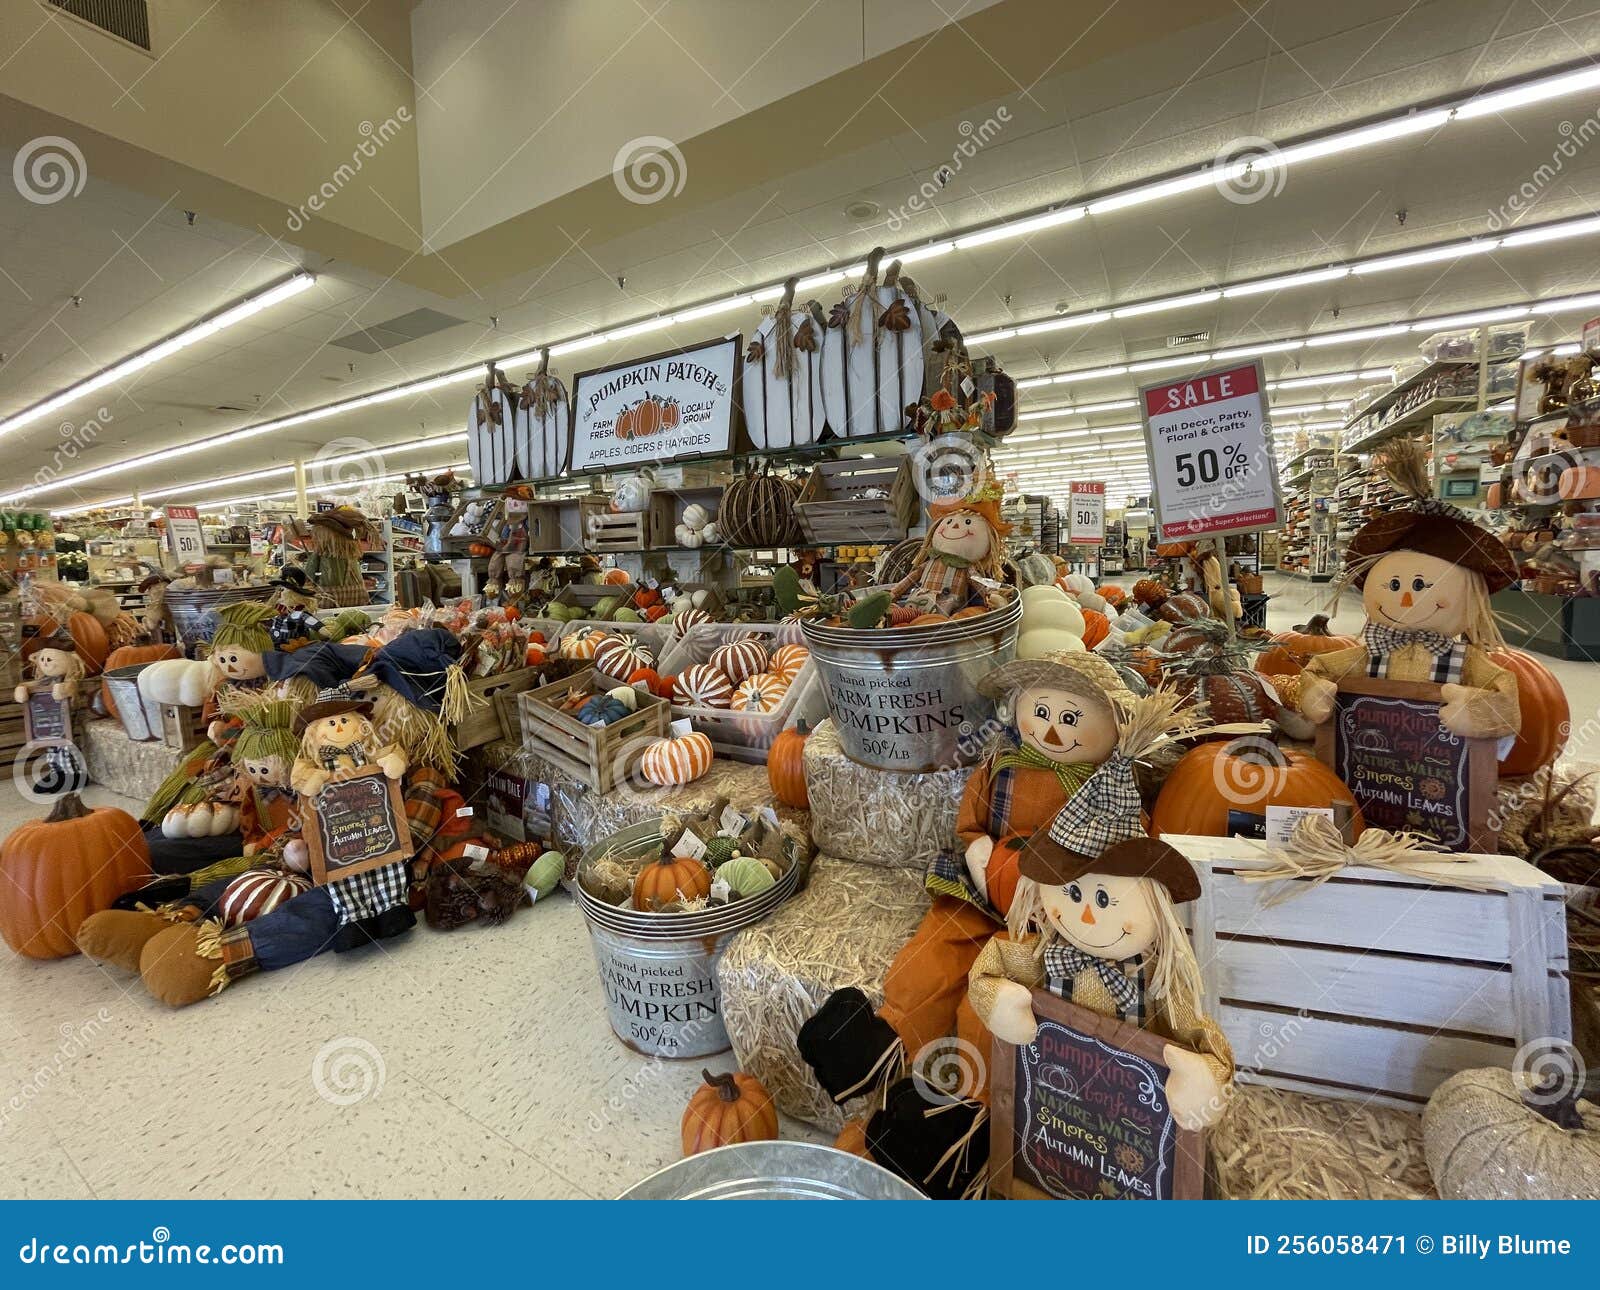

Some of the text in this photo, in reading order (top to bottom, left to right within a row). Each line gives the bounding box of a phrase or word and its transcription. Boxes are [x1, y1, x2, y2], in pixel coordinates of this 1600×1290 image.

[589, 361, 719, 412] PUMPKIN PATCH
[1167, 375, 1234, 409] SALE
[681, 400, 716, 415] LOCALLY
[592, 419, 613, 431] FARM
[683, 412, 712, 425] GROWN
[1158, 409, 1252, 435] Fall Decor, Party,
[589, 429, 615, 440] FRESH
[1166, 420, 1246, 444] Floral & Crafts
[624, 441, 656, 455] CIDERS
[665, 433, 711, 449] HAYRIDES
[1225, 463, 1250, 480] OFF
[1078, 483, 1098, 493] SALE
[172, 508, 193, 518] SALE
[839, 673, 912, 690] hand picked
[830, 683, 943, 709] FARM FRESH
[610, 954, 683, 978] hand picked
[648, 978, 714, 998] FRESH
[1041, 1035, 1137, 1089] pumpkins
[1034, 1086, 1093, 1127] NATURE
